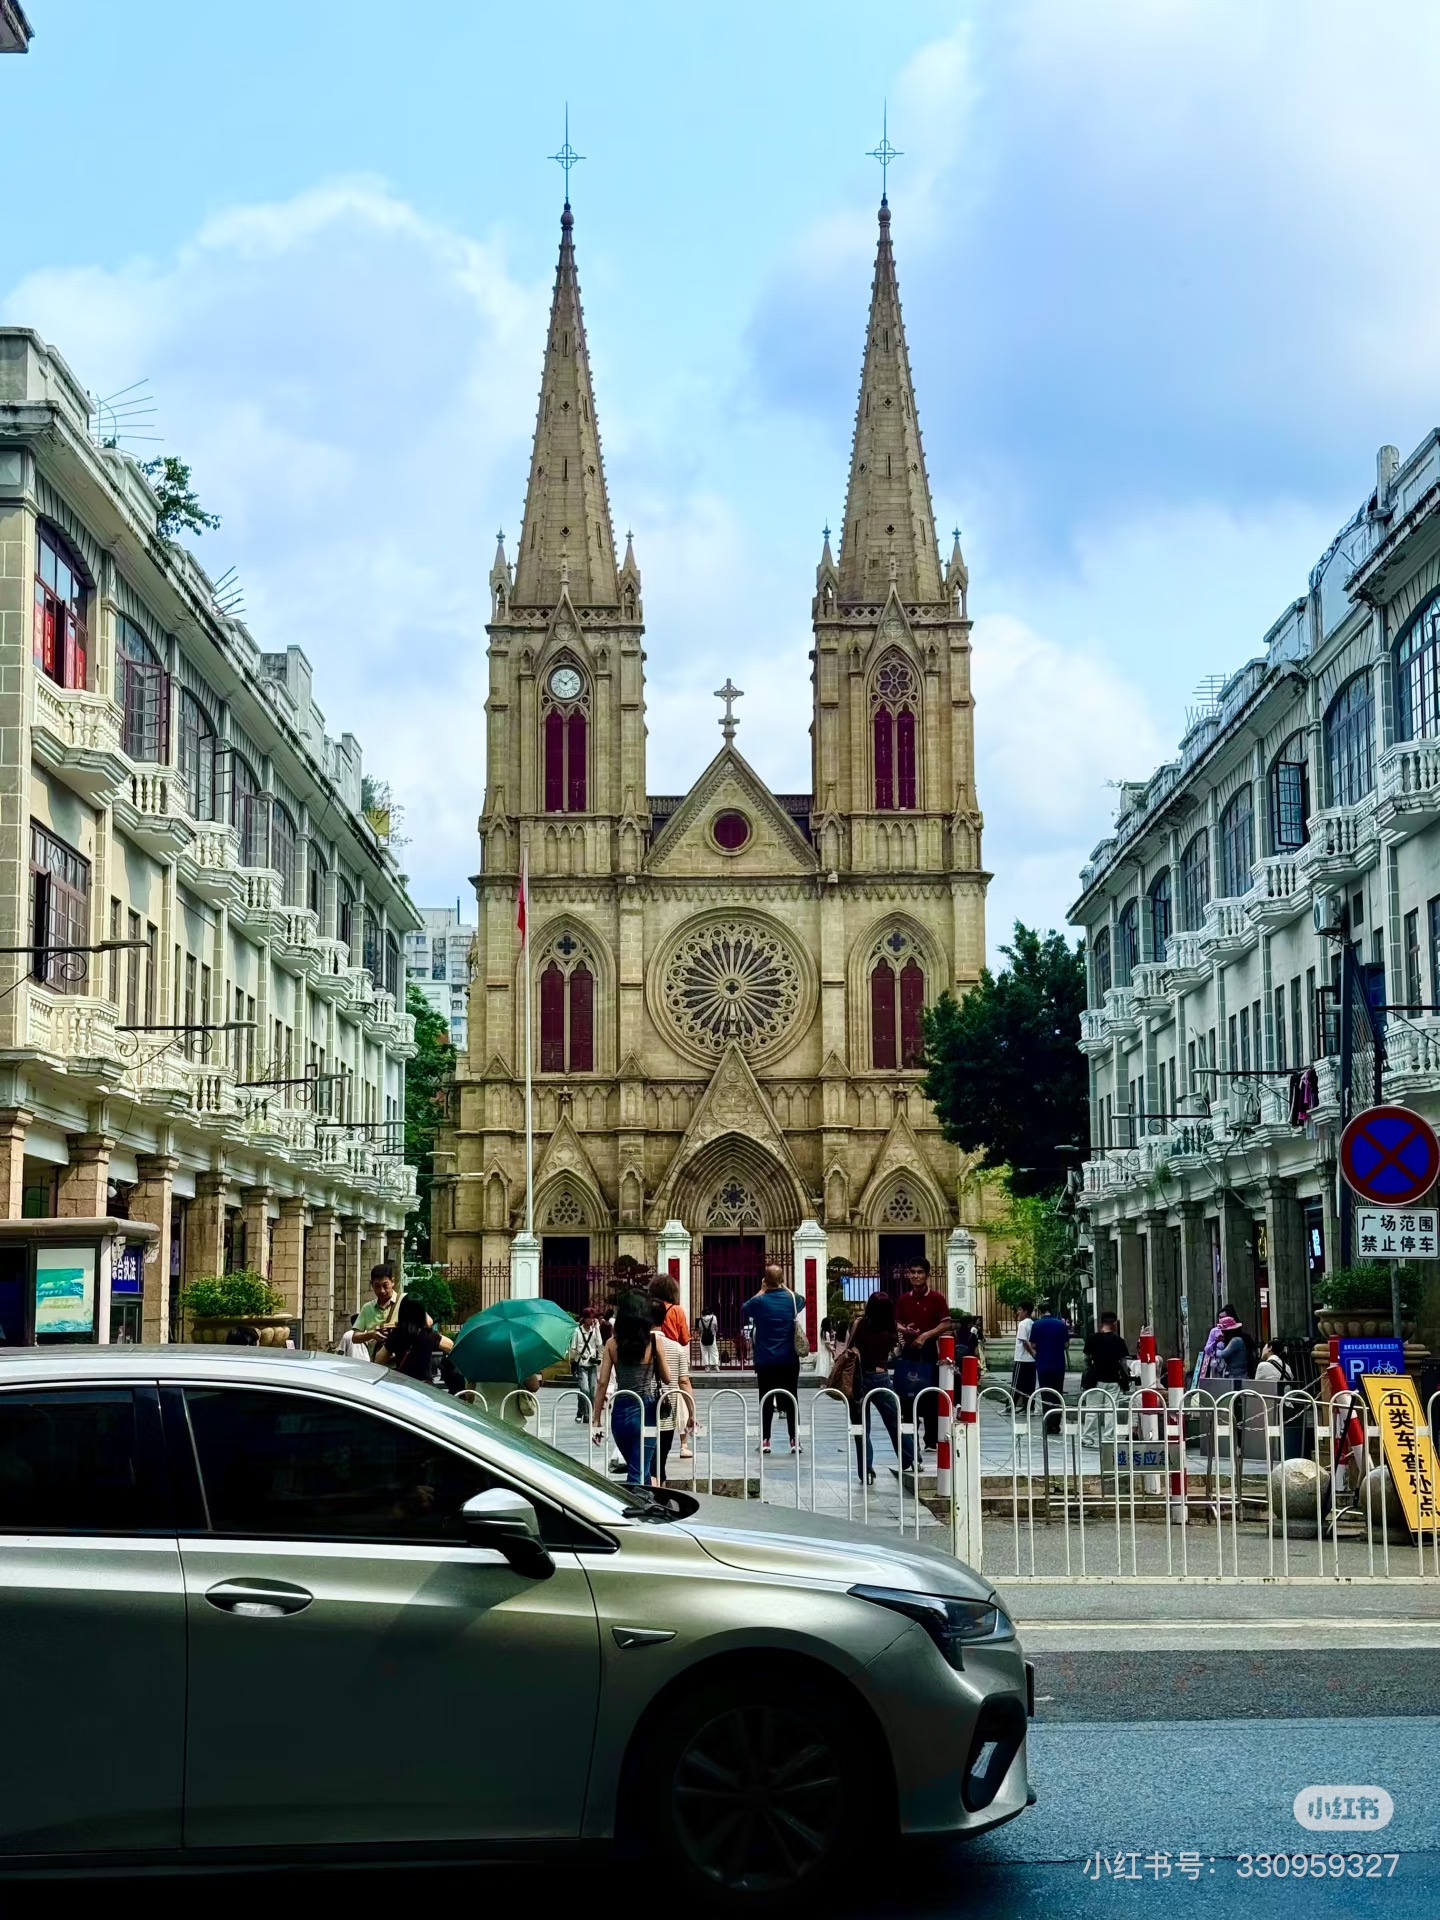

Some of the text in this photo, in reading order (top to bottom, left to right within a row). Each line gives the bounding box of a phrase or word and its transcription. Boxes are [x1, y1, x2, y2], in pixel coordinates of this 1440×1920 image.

[1361, 1214, 1433, 1232] 广场范围
[1361, 1235, 1434, 1253] 禁止停车
[1350, 1360, 1365, 1380] P
[1381, 1387, 1440, 1517] 五类车查处点
